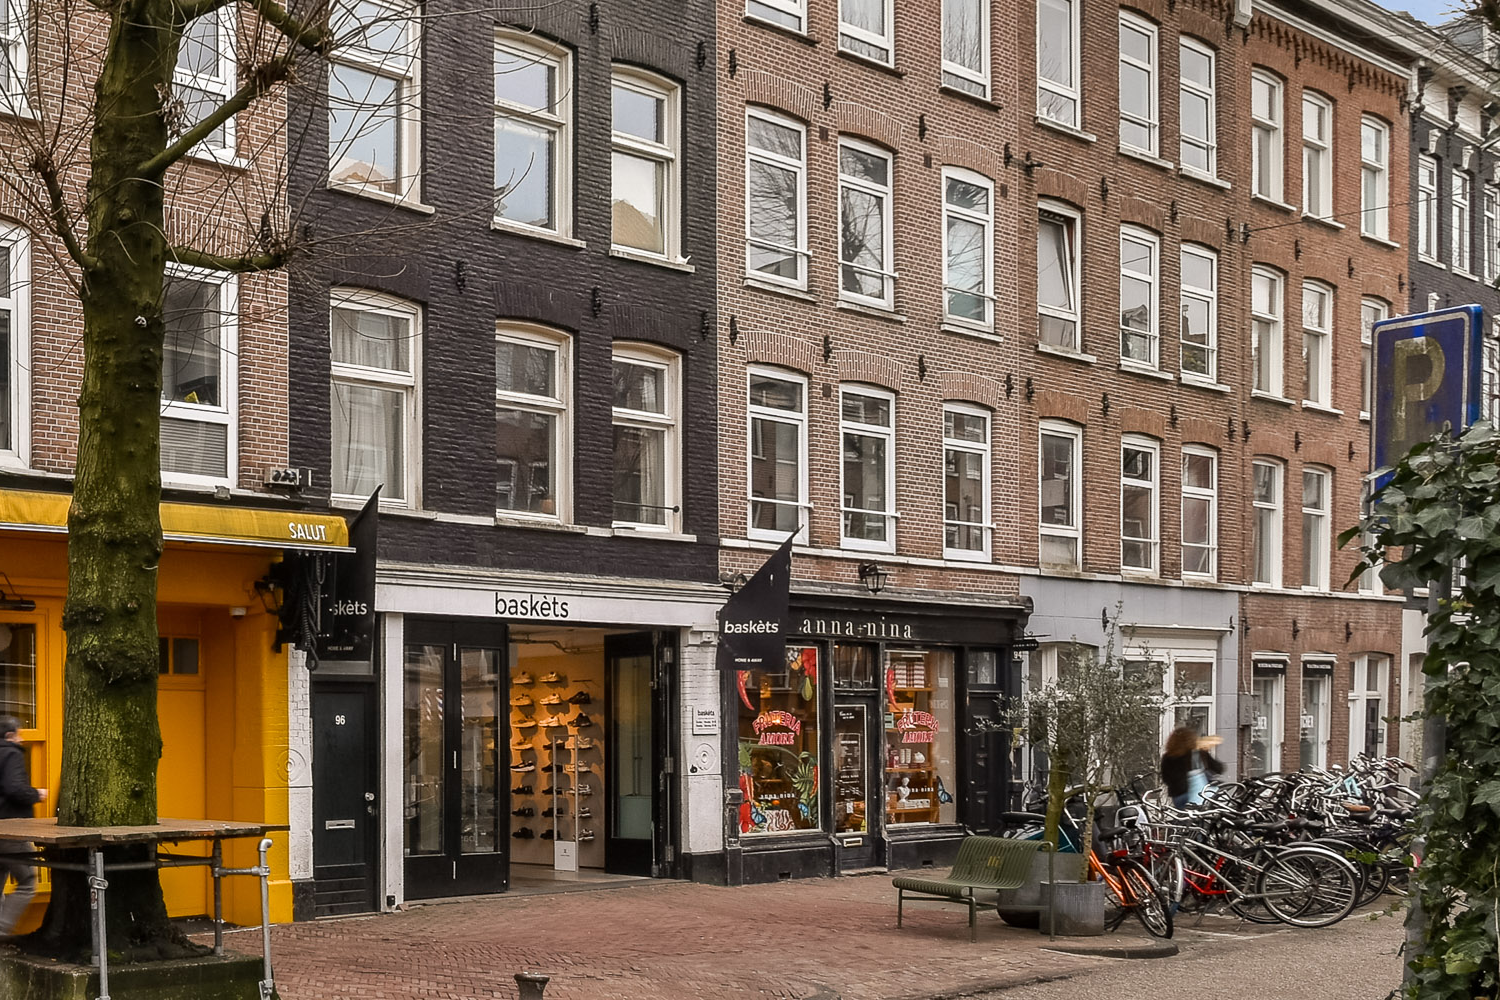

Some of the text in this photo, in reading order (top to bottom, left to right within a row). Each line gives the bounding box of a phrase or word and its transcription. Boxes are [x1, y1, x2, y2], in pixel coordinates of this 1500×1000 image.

[1392, 336, 1445, 441] P
[288, 522, 327, 541] SALUT
[333, 600, 368, 616] skèts
[495, 591, 569, 618] baskèts
[724, 620, 779, 634] baskèts
[334, 715, 346, 726] 96
[758, 732, 795, 746] AMORE
